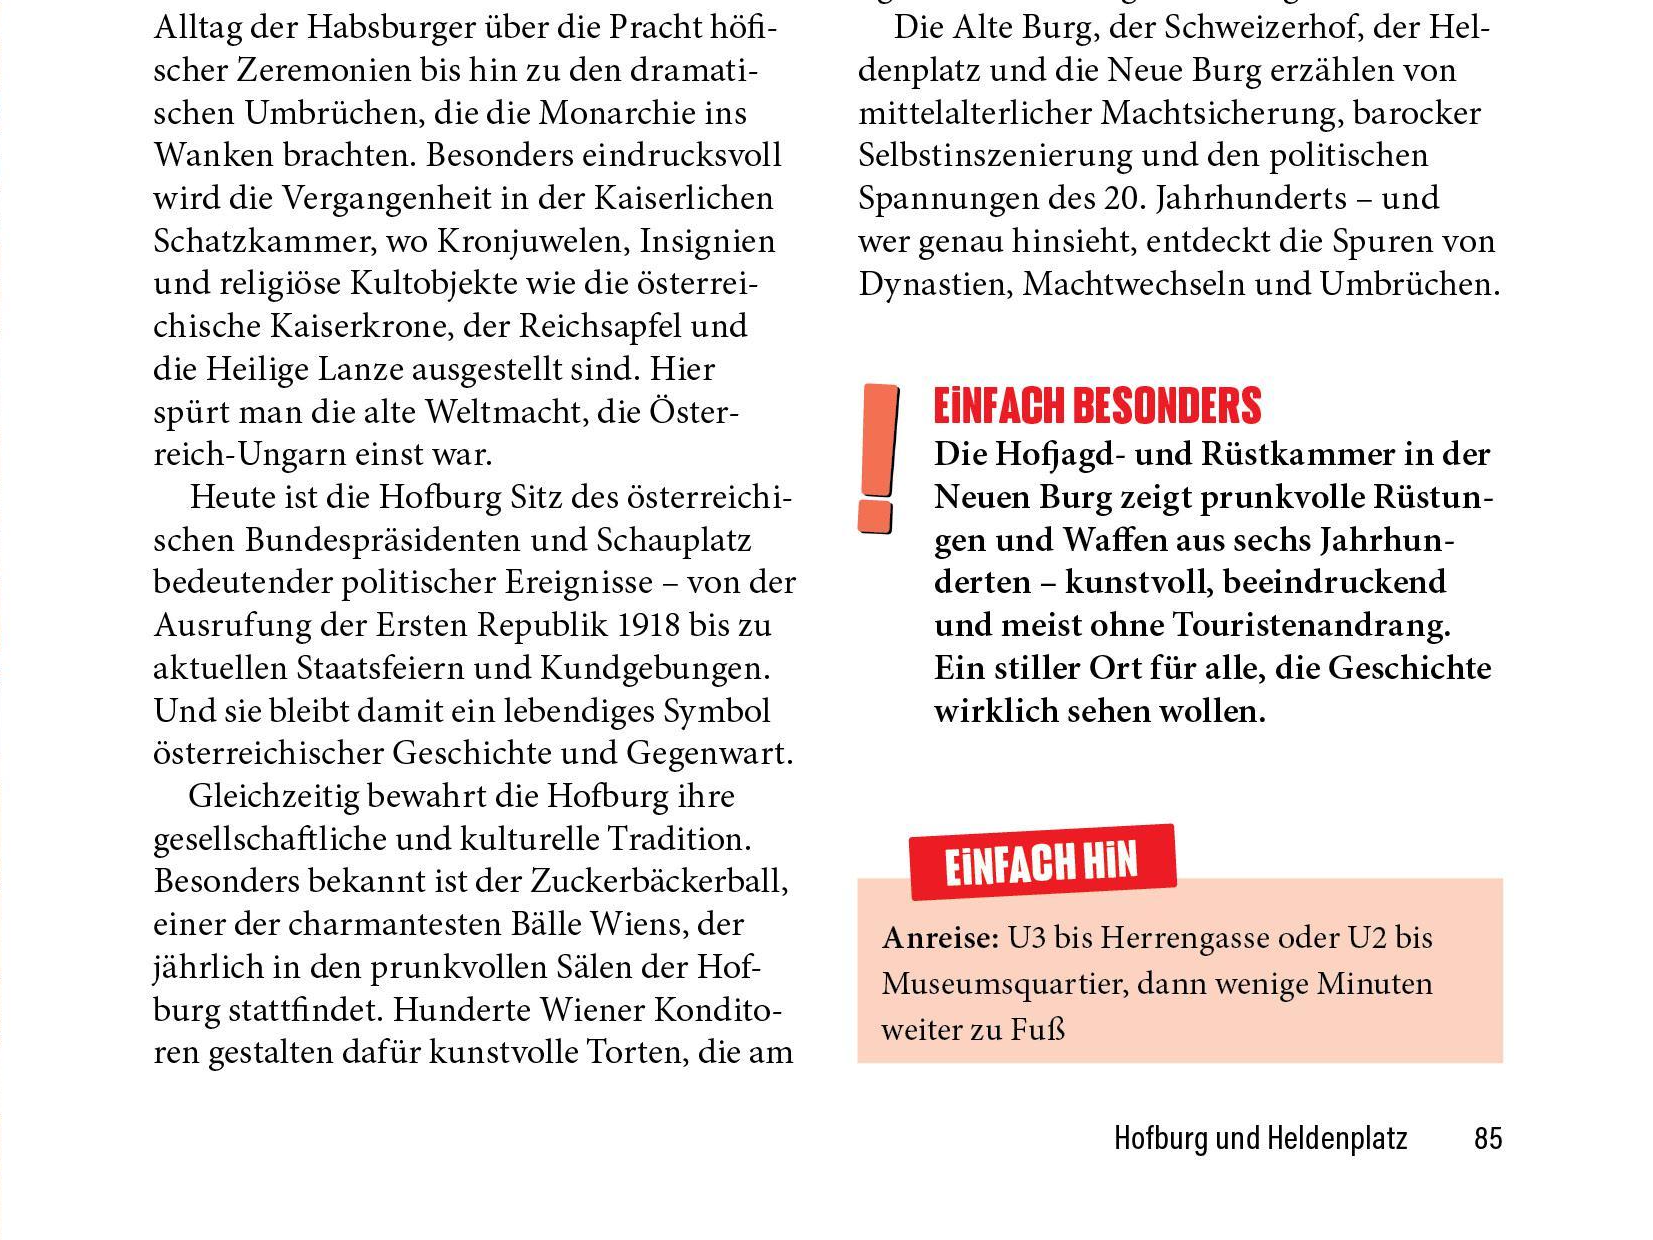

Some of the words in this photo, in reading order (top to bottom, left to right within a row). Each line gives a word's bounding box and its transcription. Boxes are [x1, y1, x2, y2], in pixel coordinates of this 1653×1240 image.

[859, 99, 1092, 124] mittelalterlicher
[1101, 99, 1343, 132] Machtsicherung,
[1353, 99, 1481, 124] barocker
[155, 227, 376, 256] Schatzkammer,
[386, 236, 427, 252] wo
[438, 227, 629, 260] Kronjuwelen,
[641, 228, 775, 260] Insignien
[1074, 386, 1261, 424] BESONDERS
[154, 440, 346, 473] reich-Ungarn
[356, 442, 423, 465] einst
[432, 449, 491, 465] war.
[935, 441, 987, 465] Die
[996, 440, 1125, 474] Hofjagd-
[1135, 440, 1193, 465] und
[1202, 440, 1395, 465] Rüstkammer
[1405, 441, 1434, 465] in
[1443, 440, 1490, 465] der
[934, 484, 1030, 508] Neuen
[1040, 484, 1112, 516] Burg
[1121, 484, 1192, 516] zeigt
[1200, 483, 1365, 516] prunkvolle
[1374, 484, 1493, 508] Rüstun-
[935, 535, 986, 559] gen
[996, 526, 1054, 551] und
[1063, 526, 1168, 551] Waffen
[1177, 535, 1225, 551] aus
[1234, 526, 1311, 551] sechs
[1321, 526, 1454, 556] Jahrhun-
[154, 611, 311, 644] Ausrufung
[321, 611, 367, 636] der
[376, 612, 467, 636] Ersten
[478, 611, 608, 644] Republik
[620, 613, 679, 636] 1918
[689, 611, 729, 636] bis
[739, 619, 771, 636] zu
[935, 611, 993, 636] und
[1002, 612, 1082, 636] meist
[1091, 611, 1164, 636] ohne
[1173, 611, 1450, 644] Touristenandrang.
[935, 655, 985, 679] Ein
[995, 654, 1080, 679] stiller
[1090, 655, 1142, 679] Ort
[1151, 654, 1196, 679] für
[1206, 654, 1265, 684] alle,
[1276, 654, 1320, 679] die
[1329, 654, 1491, 679] Geschichte
[934, 697, 1059, 722] wirklich
[1068, 697, 1151, 722] sehen
[1159, 697, 1265, 722] wollen.
[154, 825, 386, 858] gesellschaftliche
[396, 825, 452, 850] und
[460, 825, 599, 850] kulturelle
[608, 825, 750, 850] Tradition.
[882, 926, 998, 948] Anreise:
[1008, 926, 1045, 948] U3
[1054, 924, 1092, 948] bis
[1101, 926, 1269, 956] Herrengasse
[1279, 924, 1340, 948] oder
[1348, 926, 1386, 948] U2
[1395, 924, 1432, 948] bis
[882, 972, 1128, 1002] Museumsquartier,
[1138, 970, 1207, 998] dann
[1215, 972, 1308, 1002] wenige
[1317, 972, 1433, 994] Minuten
[881, 1018, 963, 1040] weiter
[971, 1024, 1002, 1040] zu
[1011, 1016, 1065, 1040] Fuß
[1116, 1125, 1207, 1156] Hofburg
[1217, 1125, 1259, 1149] und
[1269, 1125, 1407, 1156] Heldenplatz
[1475, 1127, 1502, 1149] 85
